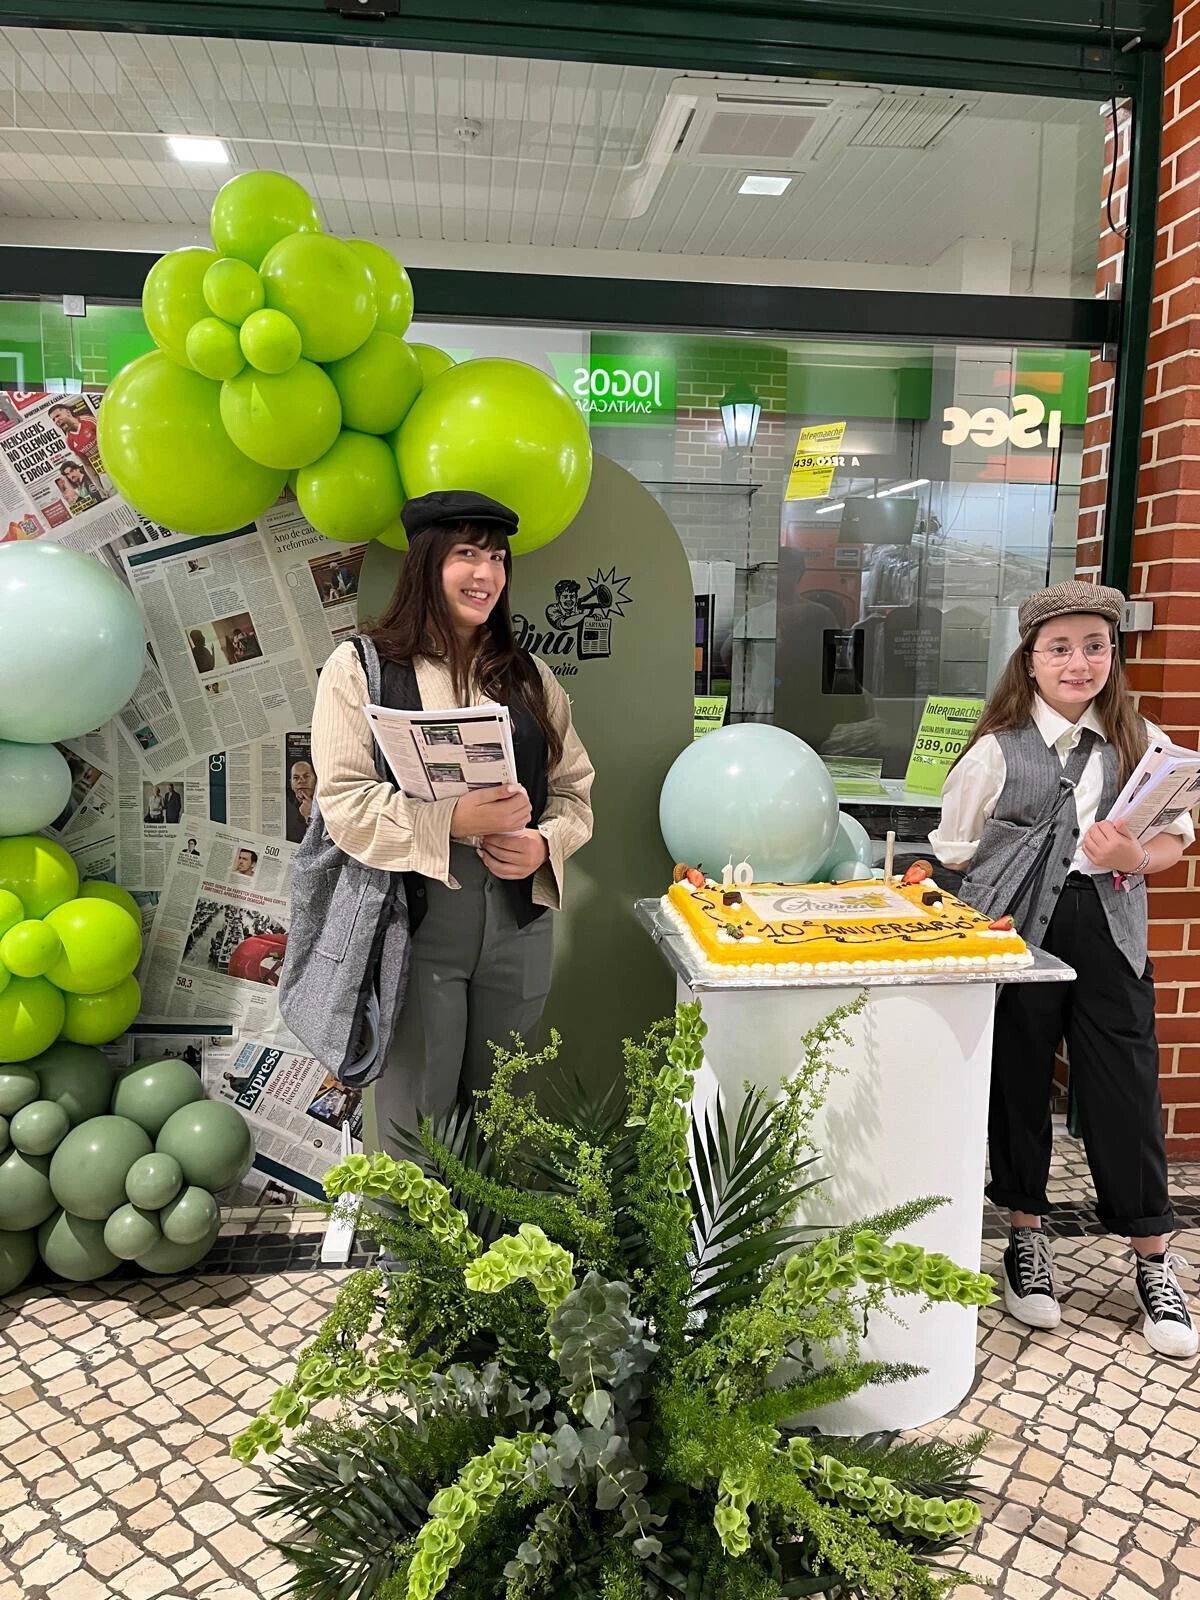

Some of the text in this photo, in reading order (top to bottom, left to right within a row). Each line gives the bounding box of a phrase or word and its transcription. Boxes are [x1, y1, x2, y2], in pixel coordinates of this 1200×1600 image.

[0, 421, 45, 452] MENSAGENS
[7, 449, 21, 463] NO
[19, 428, 61, 456] TELEMÓVEL
[13, 450, 49, 474] OCULTAM
[46, 439, 67, 457] SEXO
[20, 473, 29, 484] E
[27, 460, 54, 483] DROGA
[273, 526, 315, 544] Ano de cao
[282, 535, 319, 552] reformas
[511, 614, 576, 655] dina
[264, 845, 280, 857] 500
[721, 862, 754, 887] 10
[176, 976, 193, 989] 58,3
[238, 1049, 280, 1108] Express
[265, 1069, 285, 1096] Militares
[273, 1058, 299, 1100] ameaçam sair
[286, 1080, 302, 1105] tiverem
